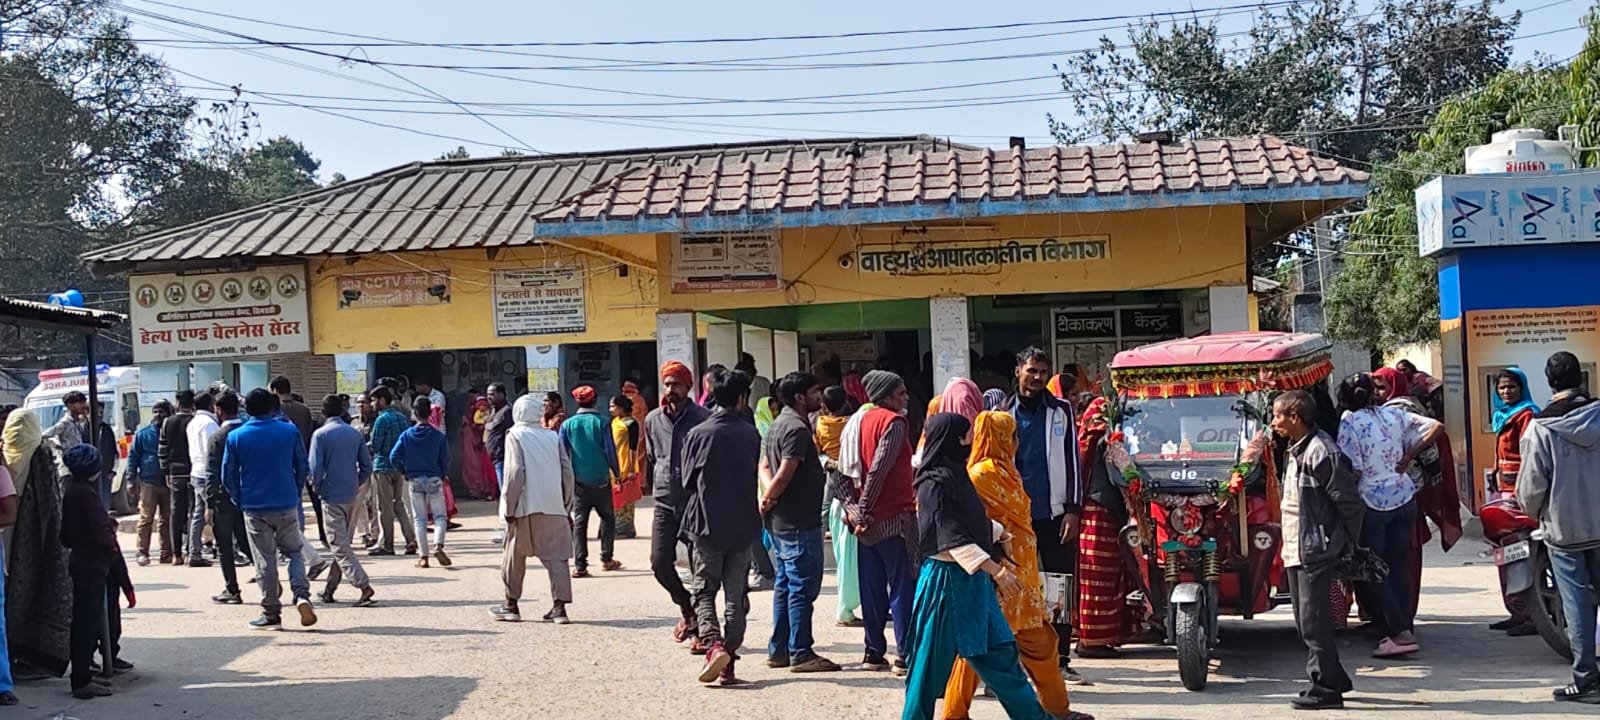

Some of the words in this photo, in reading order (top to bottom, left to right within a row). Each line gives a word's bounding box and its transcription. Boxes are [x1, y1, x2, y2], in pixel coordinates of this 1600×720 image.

[1040, 238, 1107, 262] विभाग
[365, 276, 401, 288] CCTV
[177, 326, 208, 342] एण्ड
[212, 321, 264, 339] वेलनेस
[269, 318, 301, 336] सेंटर
[1057, 314, 1113, 333] टीकाकरण
[1134, 311, 1170, 332] केन्द्र
